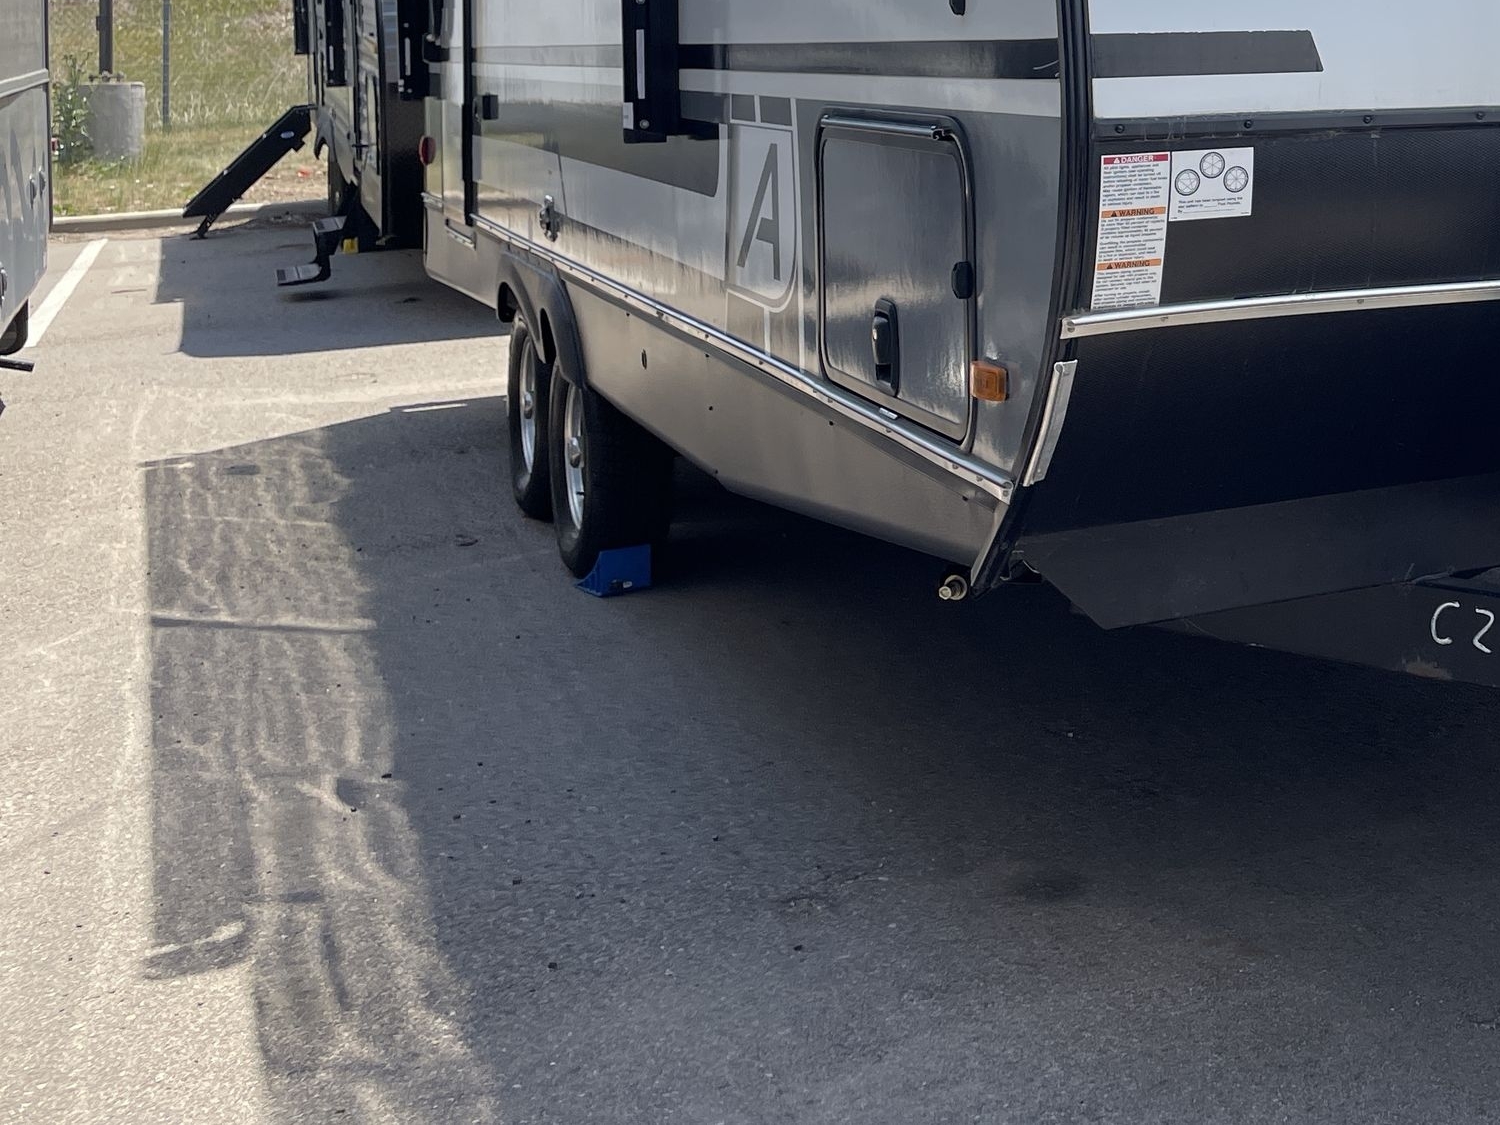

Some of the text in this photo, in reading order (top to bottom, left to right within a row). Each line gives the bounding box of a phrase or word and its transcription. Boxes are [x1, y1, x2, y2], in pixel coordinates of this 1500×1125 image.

[1120, 155, 1154, 164] DANGER
[736, 142, 781, 282] A
[1119, 207, 1155, 216] WARNING
[1114, 260, 1151, 269] WARNING
